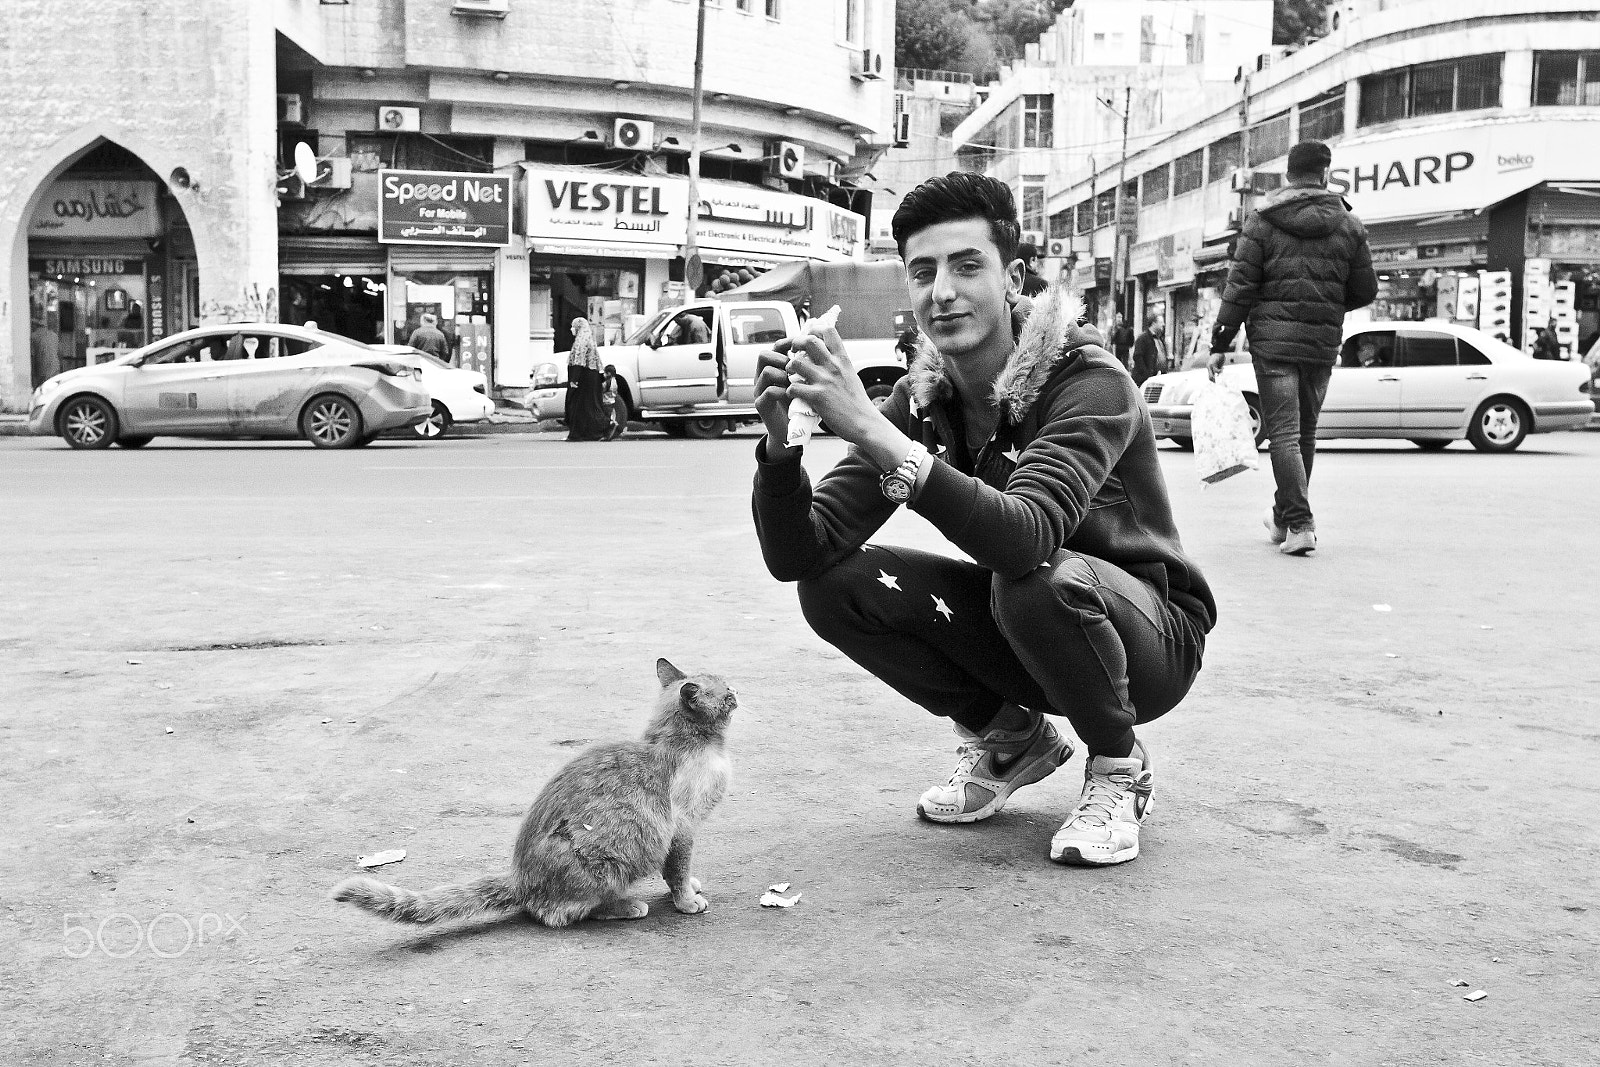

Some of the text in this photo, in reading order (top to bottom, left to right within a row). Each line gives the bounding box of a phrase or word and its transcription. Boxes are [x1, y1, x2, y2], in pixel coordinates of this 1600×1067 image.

[1497, 153, 1535, 166] beko
[1327, 151, 1474, 196] SHARP
[384, 176, 503, 205] Speed Net
[545, 180, 669, 216] VESTEL
[419, 207, 467, 220] For Mobile
[613, 217, 660, 234] البسط
[708, 229, 740, 240] Electronic
[748, 233, 777, 244] Electrical
[779, 237, 811, 248] Appliances
[46, 259, 125, 274] SAMSUNG
